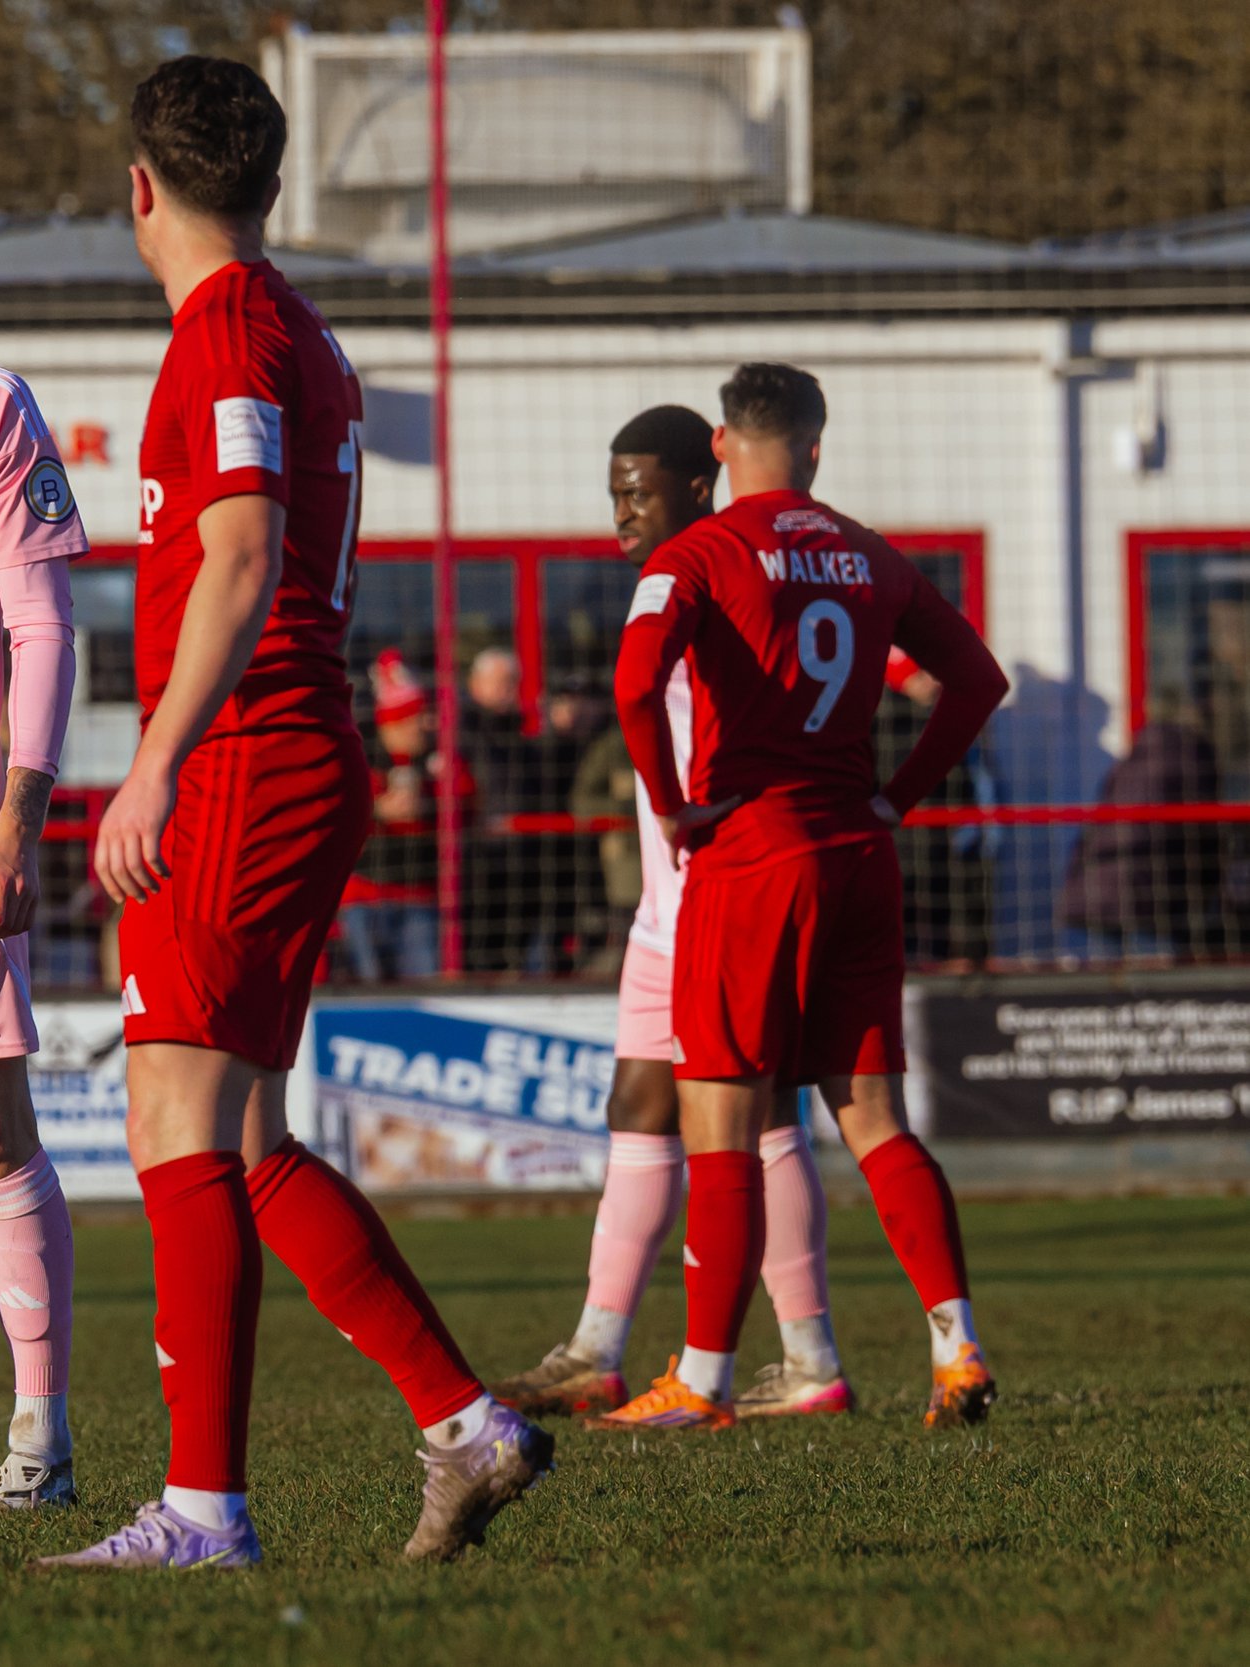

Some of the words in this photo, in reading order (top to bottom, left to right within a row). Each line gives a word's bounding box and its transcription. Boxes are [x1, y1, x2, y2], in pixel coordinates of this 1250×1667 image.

[40, 478, 61, 504] B
[757, 549, 873, 585] WALKER
[797, 599, 855, 733] 9
[328, 1035, 520, 1115] TRADE
[534, 1074, 610, 1132] SU
[1129, 1087, 1233, 1120] James
